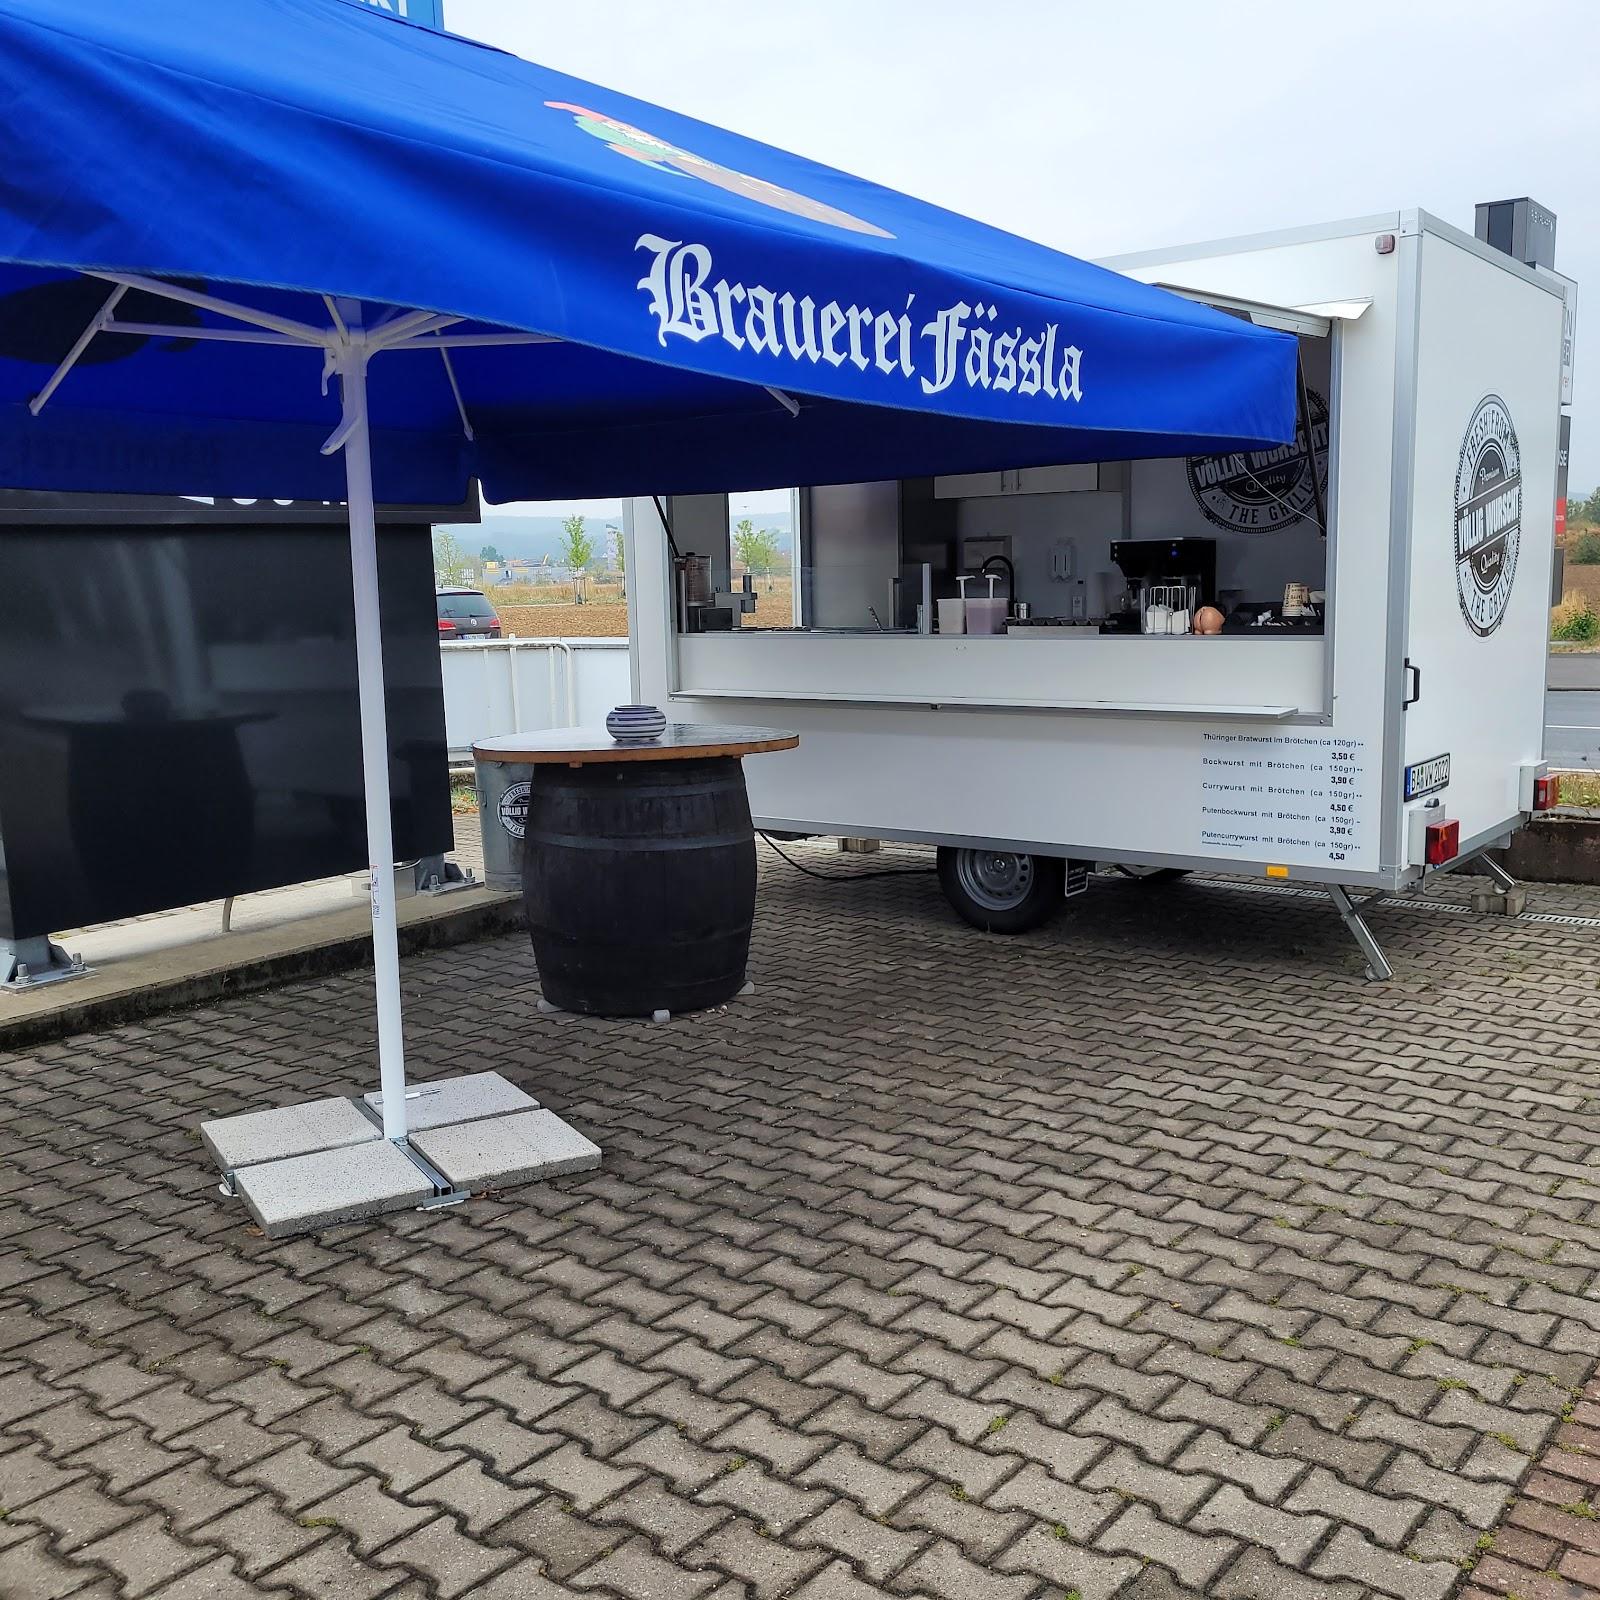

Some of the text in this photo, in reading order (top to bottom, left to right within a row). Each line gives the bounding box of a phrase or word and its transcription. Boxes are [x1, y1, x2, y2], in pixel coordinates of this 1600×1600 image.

[634, 233, 1084, 403] Brauerei Fässla
[1467, 409, 1510, 468] FRESH FROM
[1194, 453, 1246, 488] VÖLLIG
[1245, 473, 1287, 494] Quality
[1229, 504, 1259, 524] THE
[1458, 485, 1519, 555] VÖLLIG WURSCHT
[1480, 553, 1501, 574] Quality
[1470, 588, 1485, 622] THE
[1203, 734, 1236, 742] Thüringer
[1238, 735, 1272, 743] Bratwurst
[1285, 737, 1317, 745] Brötchen
[1203, 758, 1244, 766] Bockwurst
[1268, 762, 1304, 770] Brötchen
[1332, 752, 1355, 761] 3,50 €
[1434, 759, 1449, 783] 2022
[1349, 777, 1354, 785] €
[1202, 783, 1245, 792] Currywurst
[1268, 787, 1305, 795] Brötchen
[501, 806, 522, 815] VÖLLIG
[1202, 807, 1257, 816] Putenbockwurst
[1278, 813, 1310, 821] Brötchen
[1330, 804, 1346, 812] 4,50
[1202, 831, 1258, 842] Putencurrywurst
[1278, 838, 1310, 846] Brötchen
[1330, 827, 1345, 835] 3,90
